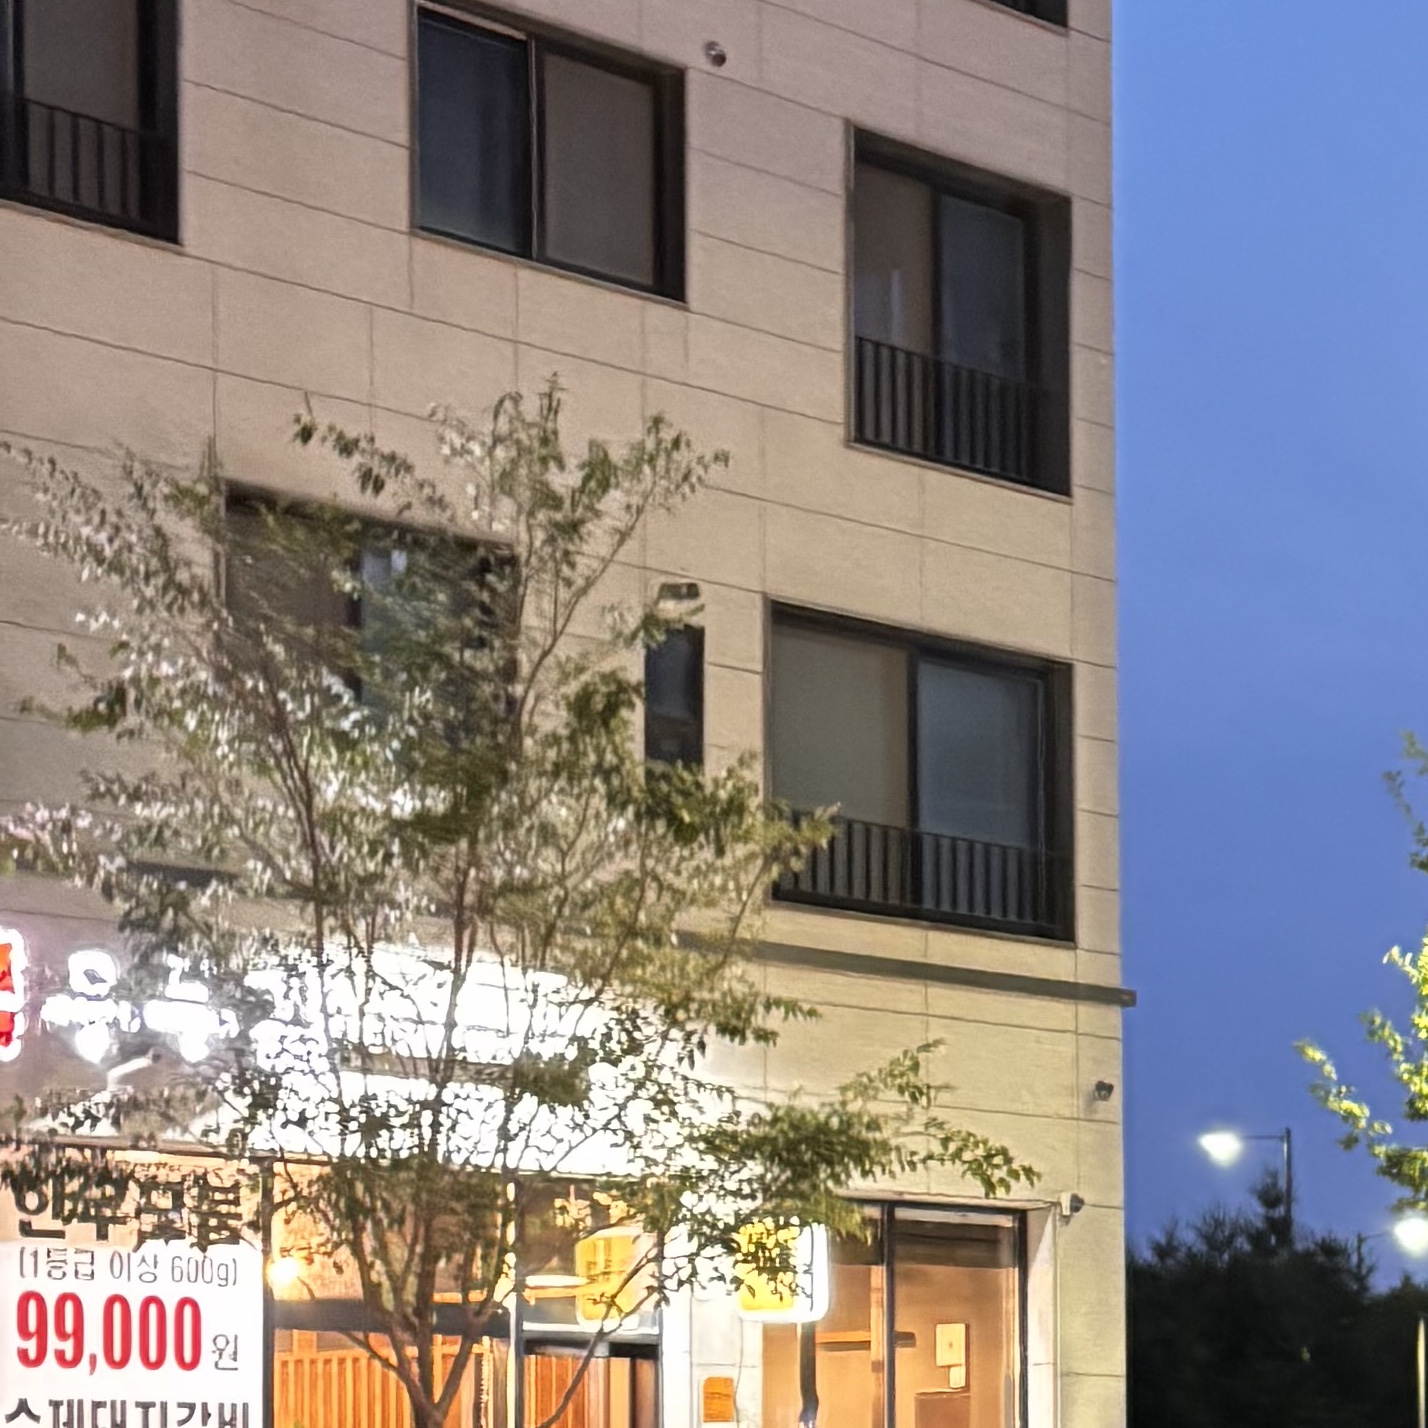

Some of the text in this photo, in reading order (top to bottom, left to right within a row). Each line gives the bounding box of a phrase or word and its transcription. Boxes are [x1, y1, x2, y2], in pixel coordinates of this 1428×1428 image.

[19, 1246, 238, 1288] (1등급 이상 600g)
